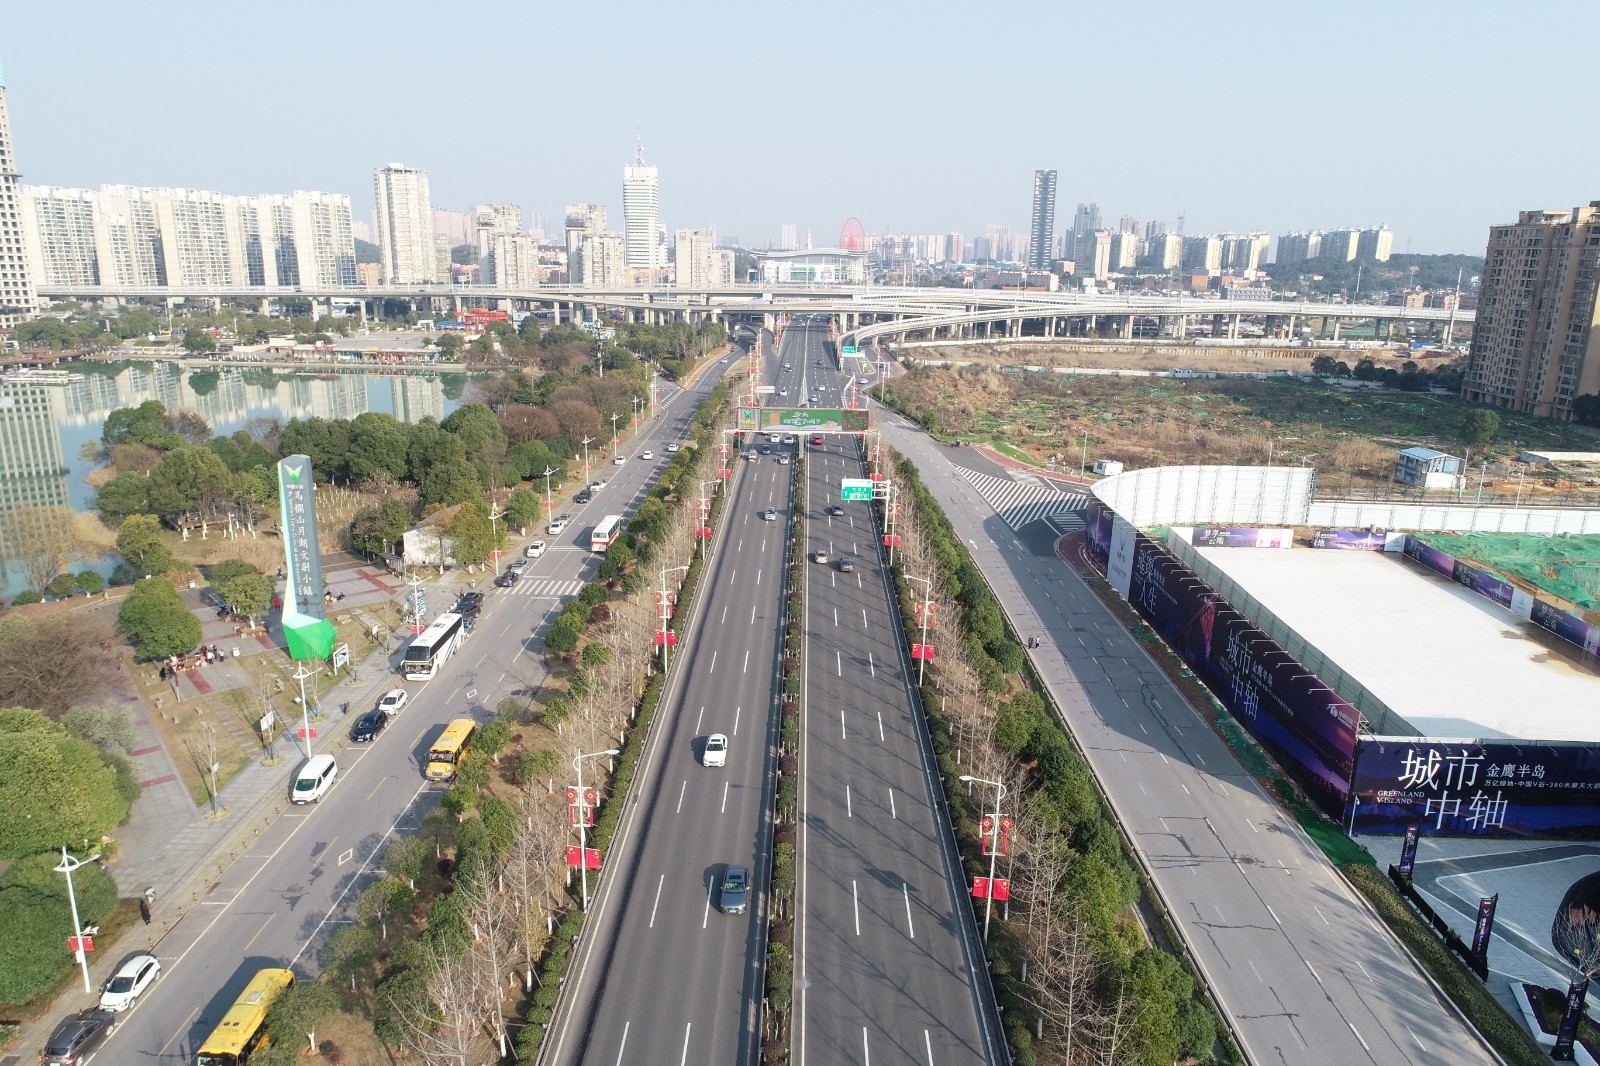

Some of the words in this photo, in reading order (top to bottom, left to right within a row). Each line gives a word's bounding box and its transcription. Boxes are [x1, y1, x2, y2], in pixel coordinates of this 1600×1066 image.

[1226, 628, 1253, 675] 城市
[1232, 671, 1259, 721] 中轴
[1398, 748, 1485, 791] 城市
[1485, 763, 1546, 778] 金鹰半岛
[1377, 789, 1425, 798] GREENLAND
[1424, 789, 1509, 830] 中轴
